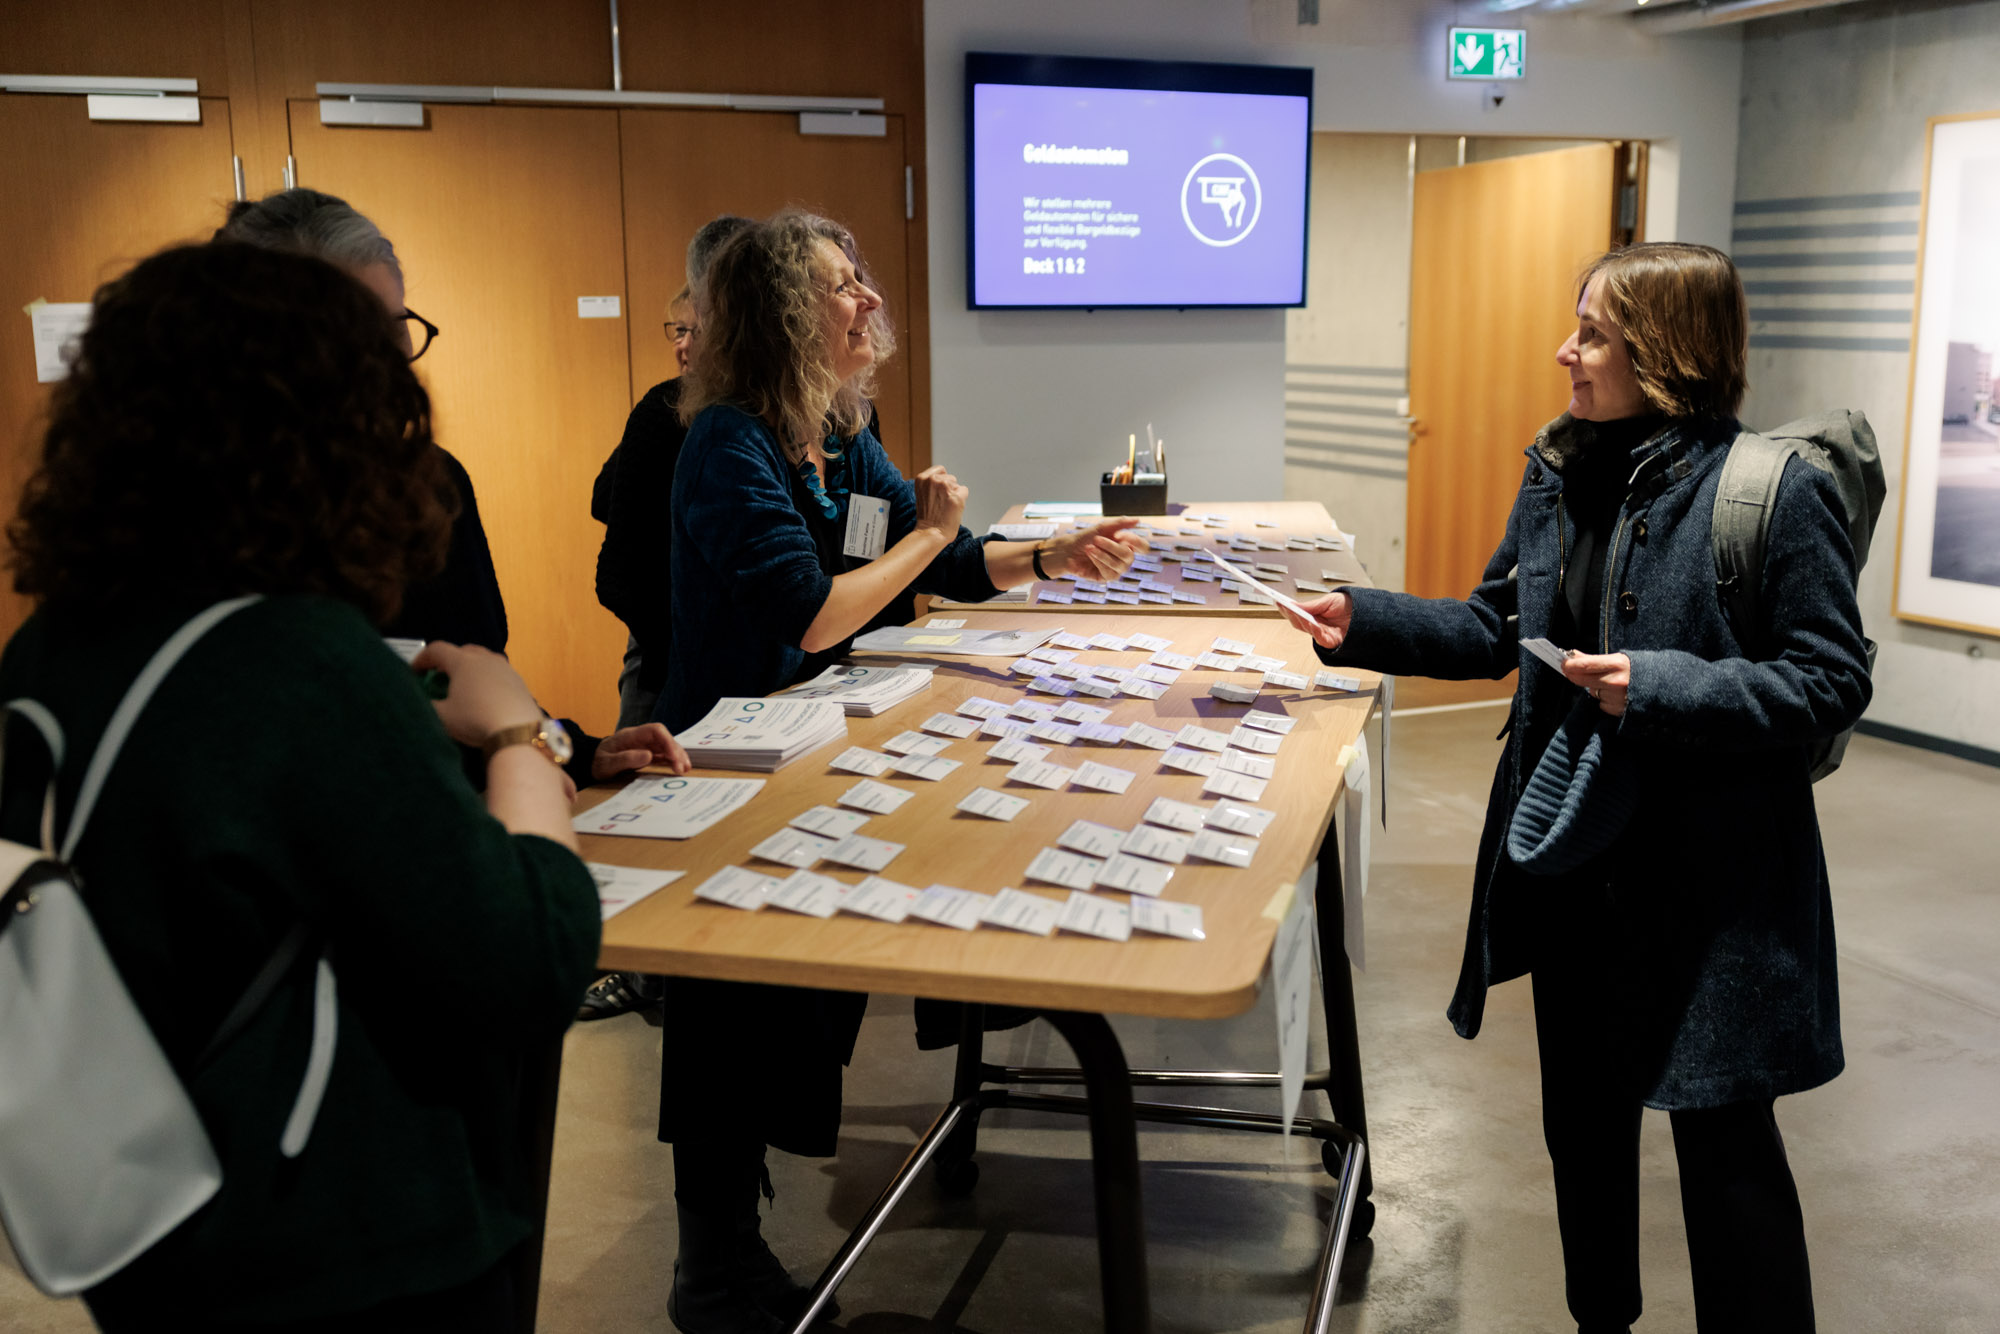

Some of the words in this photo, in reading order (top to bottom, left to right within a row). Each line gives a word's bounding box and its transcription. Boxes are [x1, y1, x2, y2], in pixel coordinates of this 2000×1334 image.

[1024, 143, 1128, 165] Geldautomaten
[1023, 197, 1040, 208] Wir
[1042, 198, 1072, 209] stellen
[1073, 198, 1112, 210] mehrere
[1024, 209, 1090, 222] Geldautomaten
[1106, 211, 1139, 223] sichere
[1024, 223, 1042, 235] und
[1024, 238, 1039, 248] zur
[1056, 257, 1064, 274] 1
[1065, 257, 1075, 274] &
[1076, 257, 1086, 274] 2
